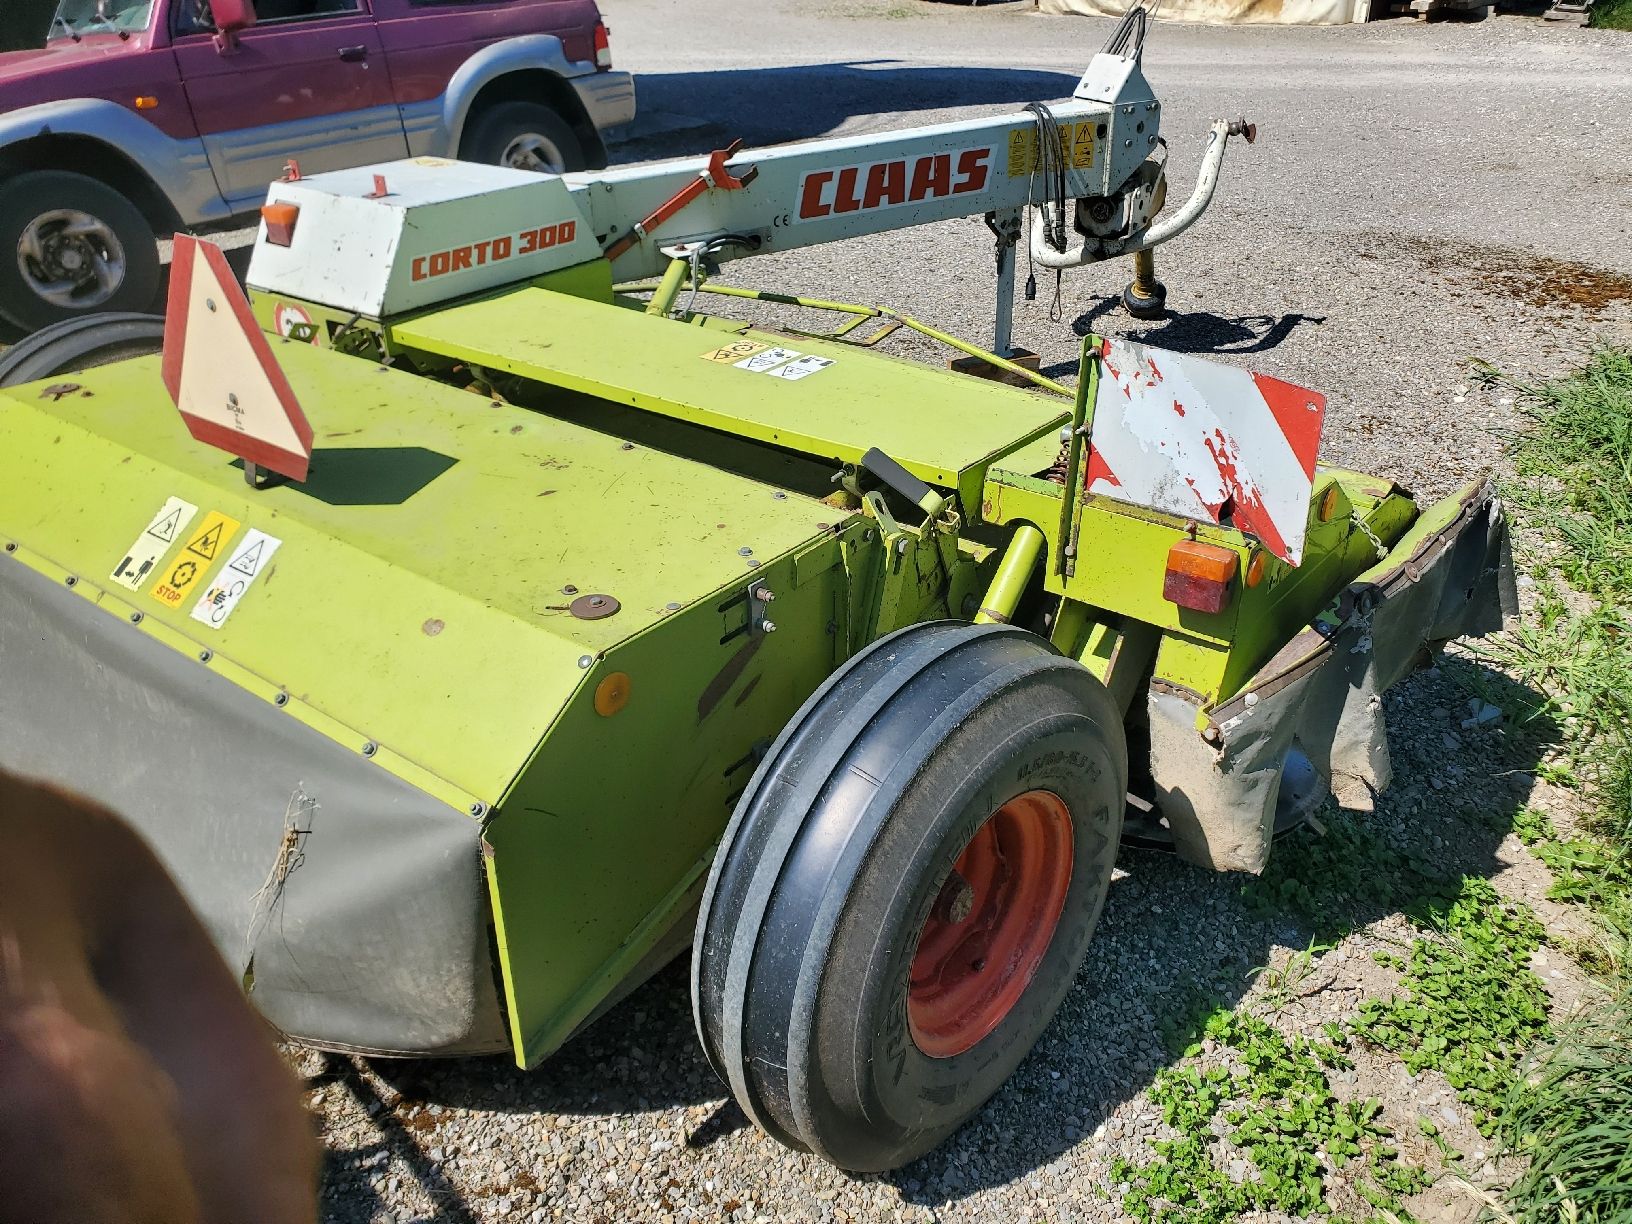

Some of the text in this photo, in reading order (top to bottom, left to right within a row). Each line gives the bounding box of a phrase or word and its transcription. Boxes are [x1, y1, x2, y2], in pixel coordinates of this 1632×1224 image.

[800, 148, 990, 219] CLAAS
[412, 220, 576, 282] CORTO 300
[156, 585, 182, 602] STOP
